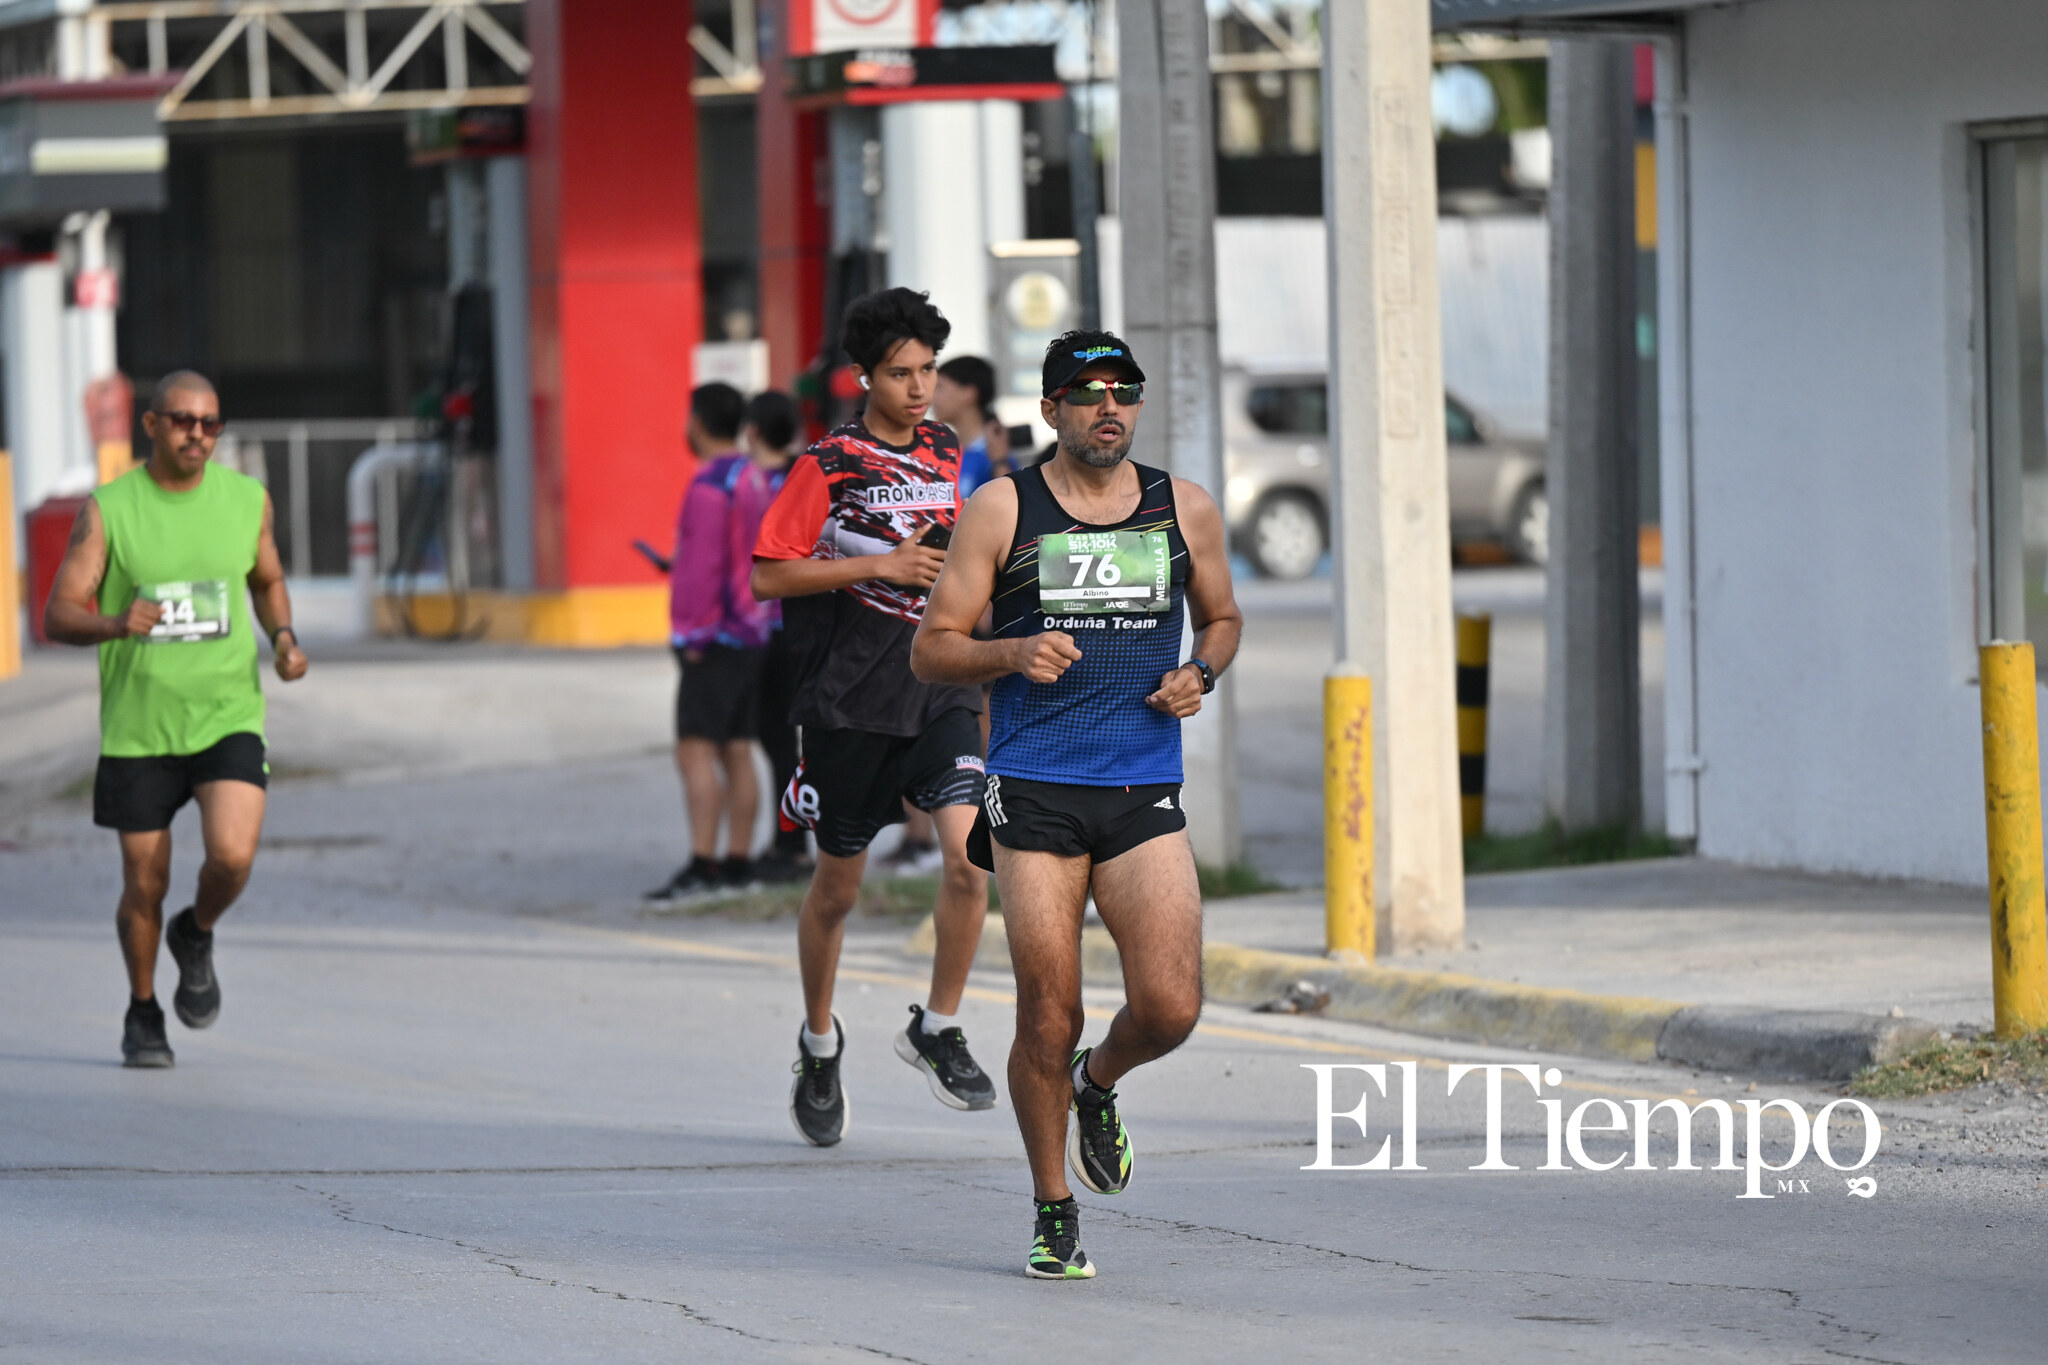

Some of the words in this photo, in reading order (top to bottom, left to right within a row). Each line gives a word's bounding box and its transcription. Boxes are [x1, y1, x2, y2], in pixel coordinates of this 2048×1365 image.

[1068, 533, 1117, 541] CARRERA
[1068, 553, 1121, 587] 76
[1155, 547, 1166, 601] MEDALLA
[1043, 616, 1106, 630] Orduña
[1112, 617, 1158, 630] Team
